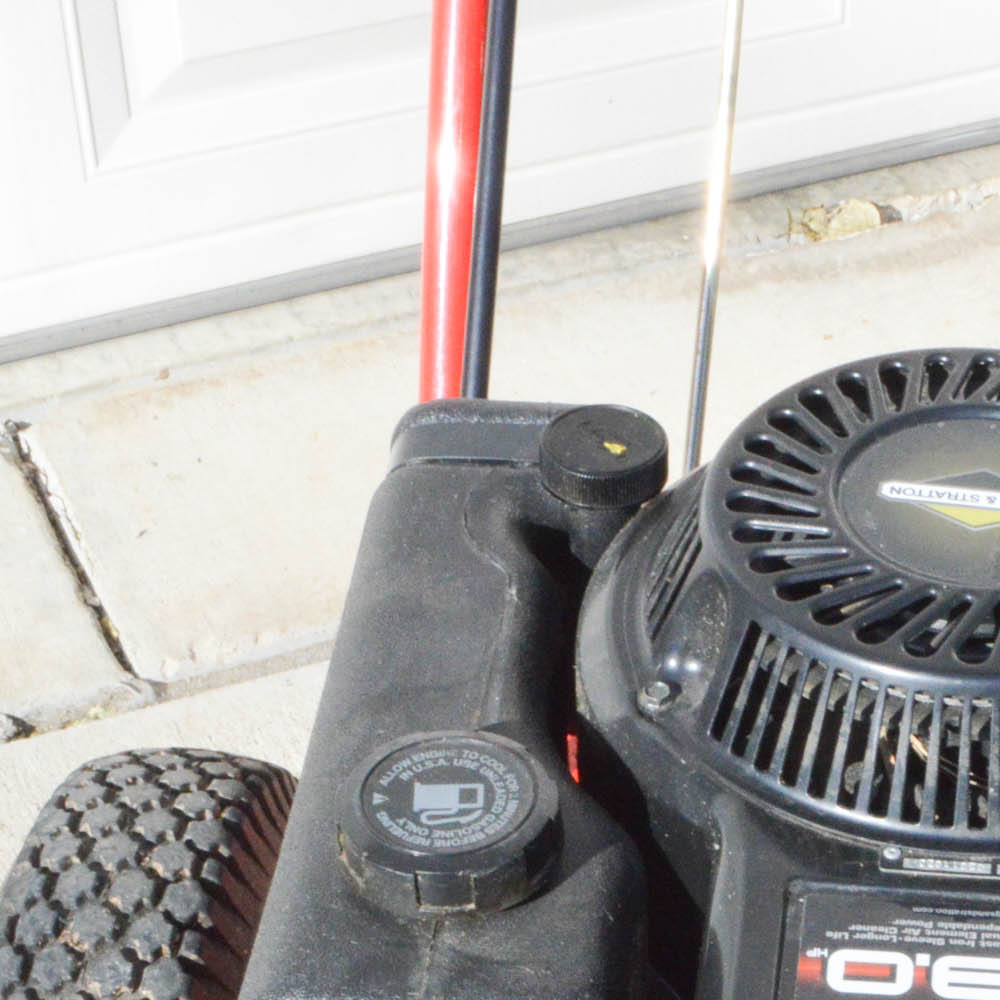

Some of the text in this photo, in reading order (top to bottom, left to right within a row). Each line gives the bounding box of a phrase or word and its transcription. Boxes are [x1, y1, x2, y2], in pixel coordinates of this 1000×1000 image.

[889, 486, 980, 503] STRATTON
[986, 496, 997, 504] &
[411, 750, 457, 763] ENGI
[462, 750, 478, 760] TO
[453, 758, 481, 770] USE
[480, 755, 504, 777] COOL
[379, 757, 412, 787] ALLOW
[399, 769, 414, 782] IN
[484, 800, 520, 835] MINUTES
[376, 811, 432, 848] REFUELING
[395, 817, 430, 836] ONLY
[432, 814, 496, 838] GASOLINE
[432, 830, 487, 848] BEFORE
[848, 923, 898, 935] Cleaner
[892, 918, 933, 929] Power
[825, 930, 849, 940] Life
[901, 927, 921, 937] Air
[925, 929, 977, 940] Element
[950, 938, 975, 948] Iron
[806, 947, 828, 957] HP
